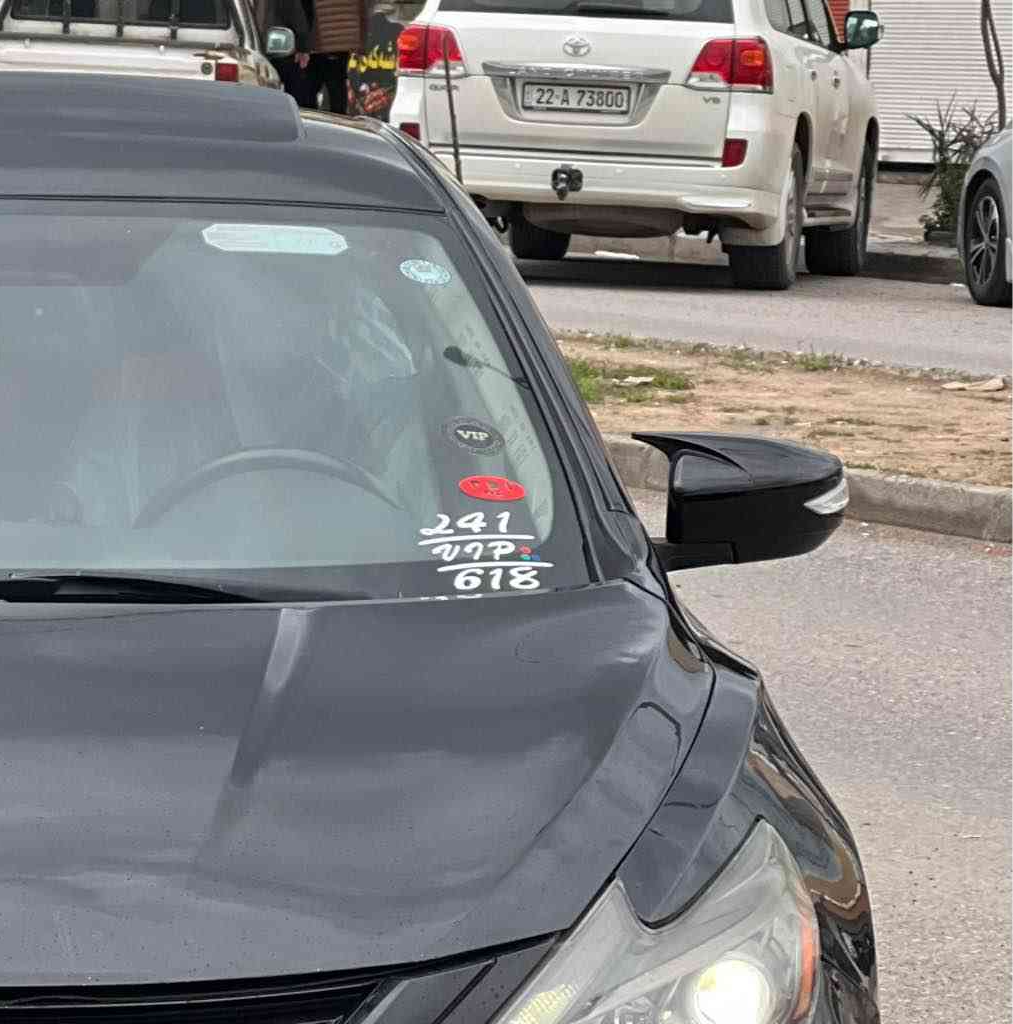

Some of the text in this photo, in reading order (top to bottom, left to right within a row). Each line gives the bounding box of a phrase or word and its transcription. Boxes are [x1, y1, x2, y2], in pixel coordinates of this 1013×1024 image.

[535, 87, 625, 109] 22 A 73800
[456, 429, 490, 442] VIP
[418, 510, 511, 536] 241
[453, 566, 541, 590] 618
